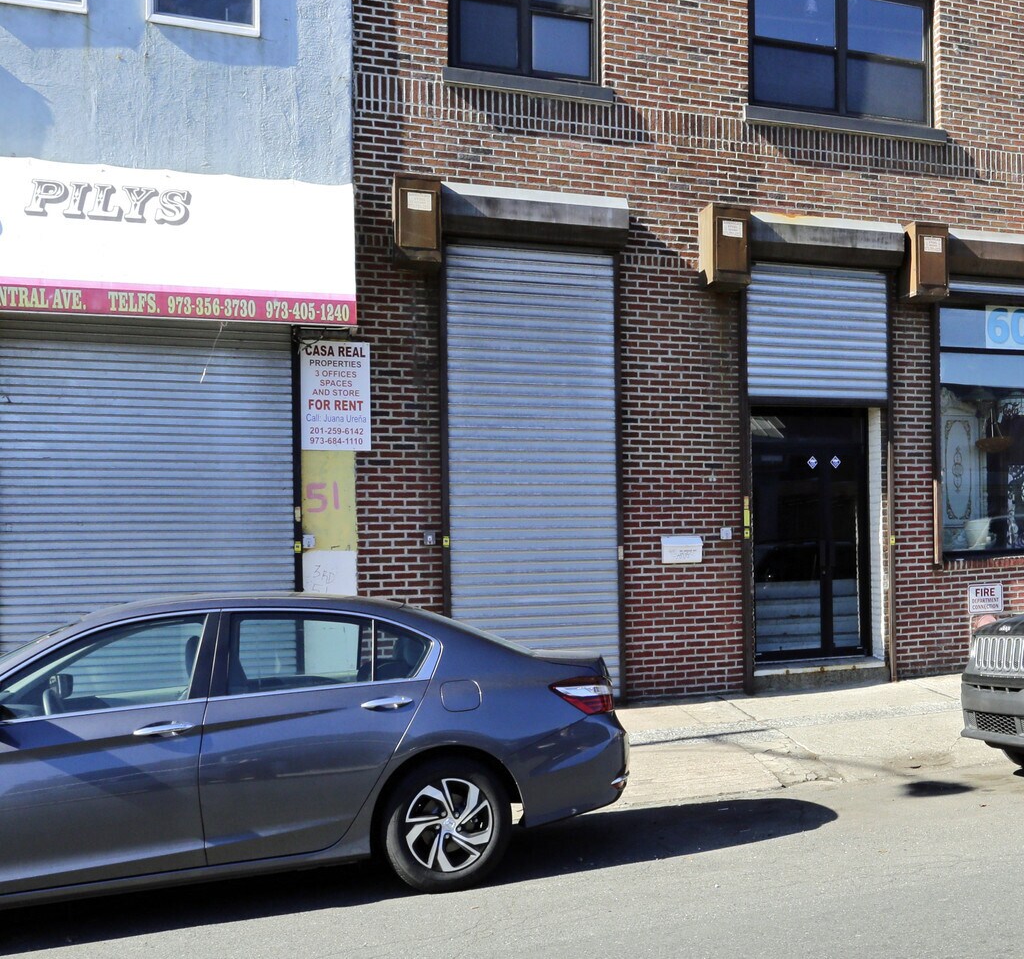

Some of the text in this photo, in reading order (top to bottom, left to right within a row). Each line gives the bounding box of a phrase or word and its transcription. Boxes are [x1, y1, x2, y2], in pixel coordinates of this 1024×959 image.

[24, 178, 192, 226] PILYS
[52, 288, 86, 310] AVE.
[108, 291, 160, 313] TELFS.
[167, 295, 256, 317] 973-356-3730
[265, 300, 350, 322] 973-405-1240
[305, 345, 366, 357] CASA REAL
[309, 359, 361, 368] PROPERTIES
[322, 370, 357, 378] OFFICES
[332, 389, 360, 397] STORE
[308, 399, 363, 411] FOR RENT
[306, 413, 321, 422] Call:
[323, 414, 344, 423] Juana
[310, 427, 364, 435] 201-259-6142
[310, 437, 363, 445] 973-684-1110
[975, 588, 995, 597] FIRE
